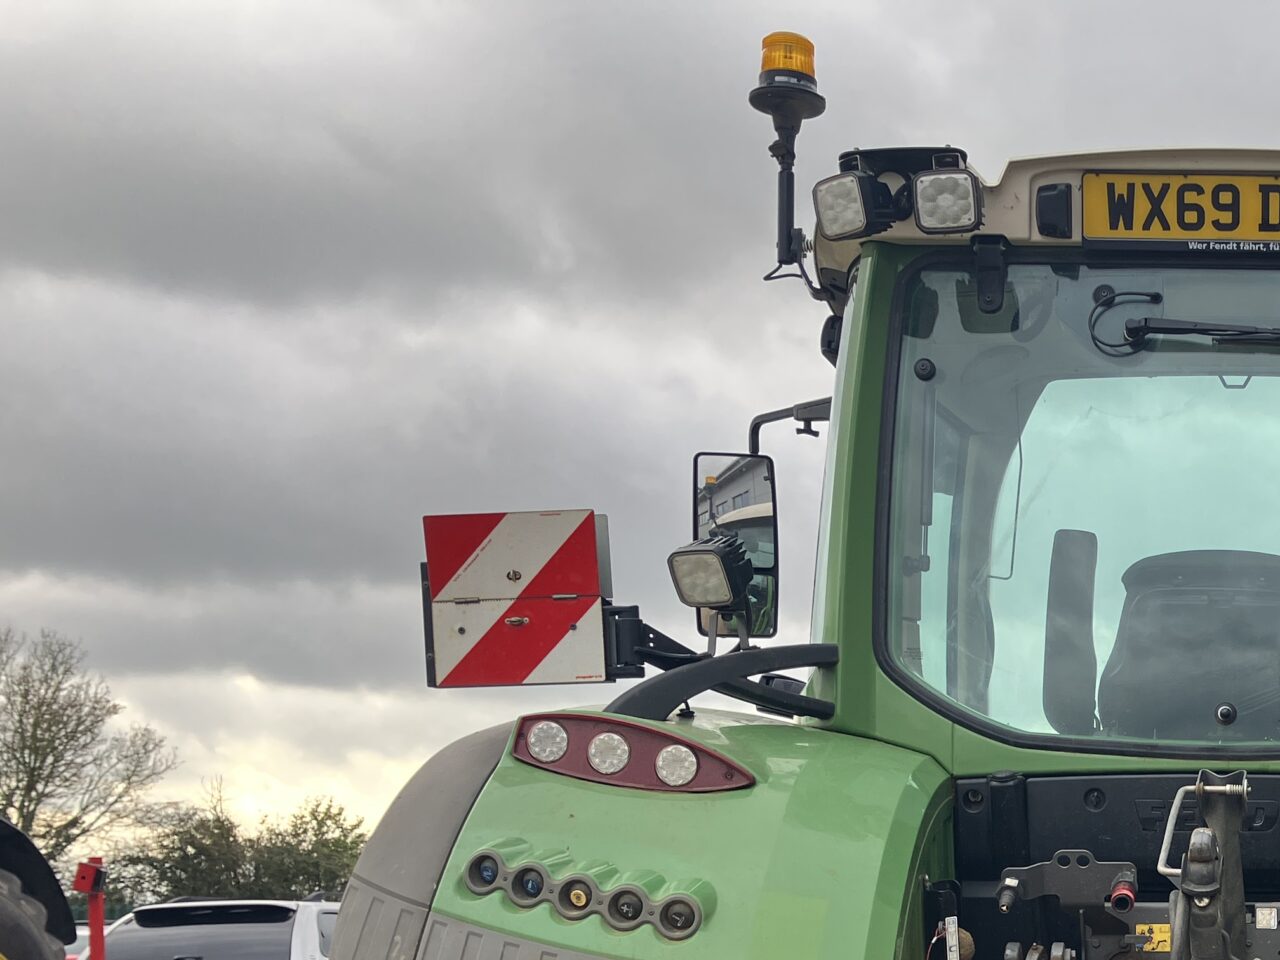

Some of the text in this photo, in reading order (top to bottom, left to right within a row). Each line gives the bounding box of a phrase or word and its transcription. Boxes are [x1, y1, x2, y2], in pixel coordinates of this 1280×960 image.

[1107, 182, 1240, 232] WX69
[1187, 241, 1208, 250] Wer
[1209, 241, 1238, 250] Fendt
[1239, 241, 1267, 252] fährt,
